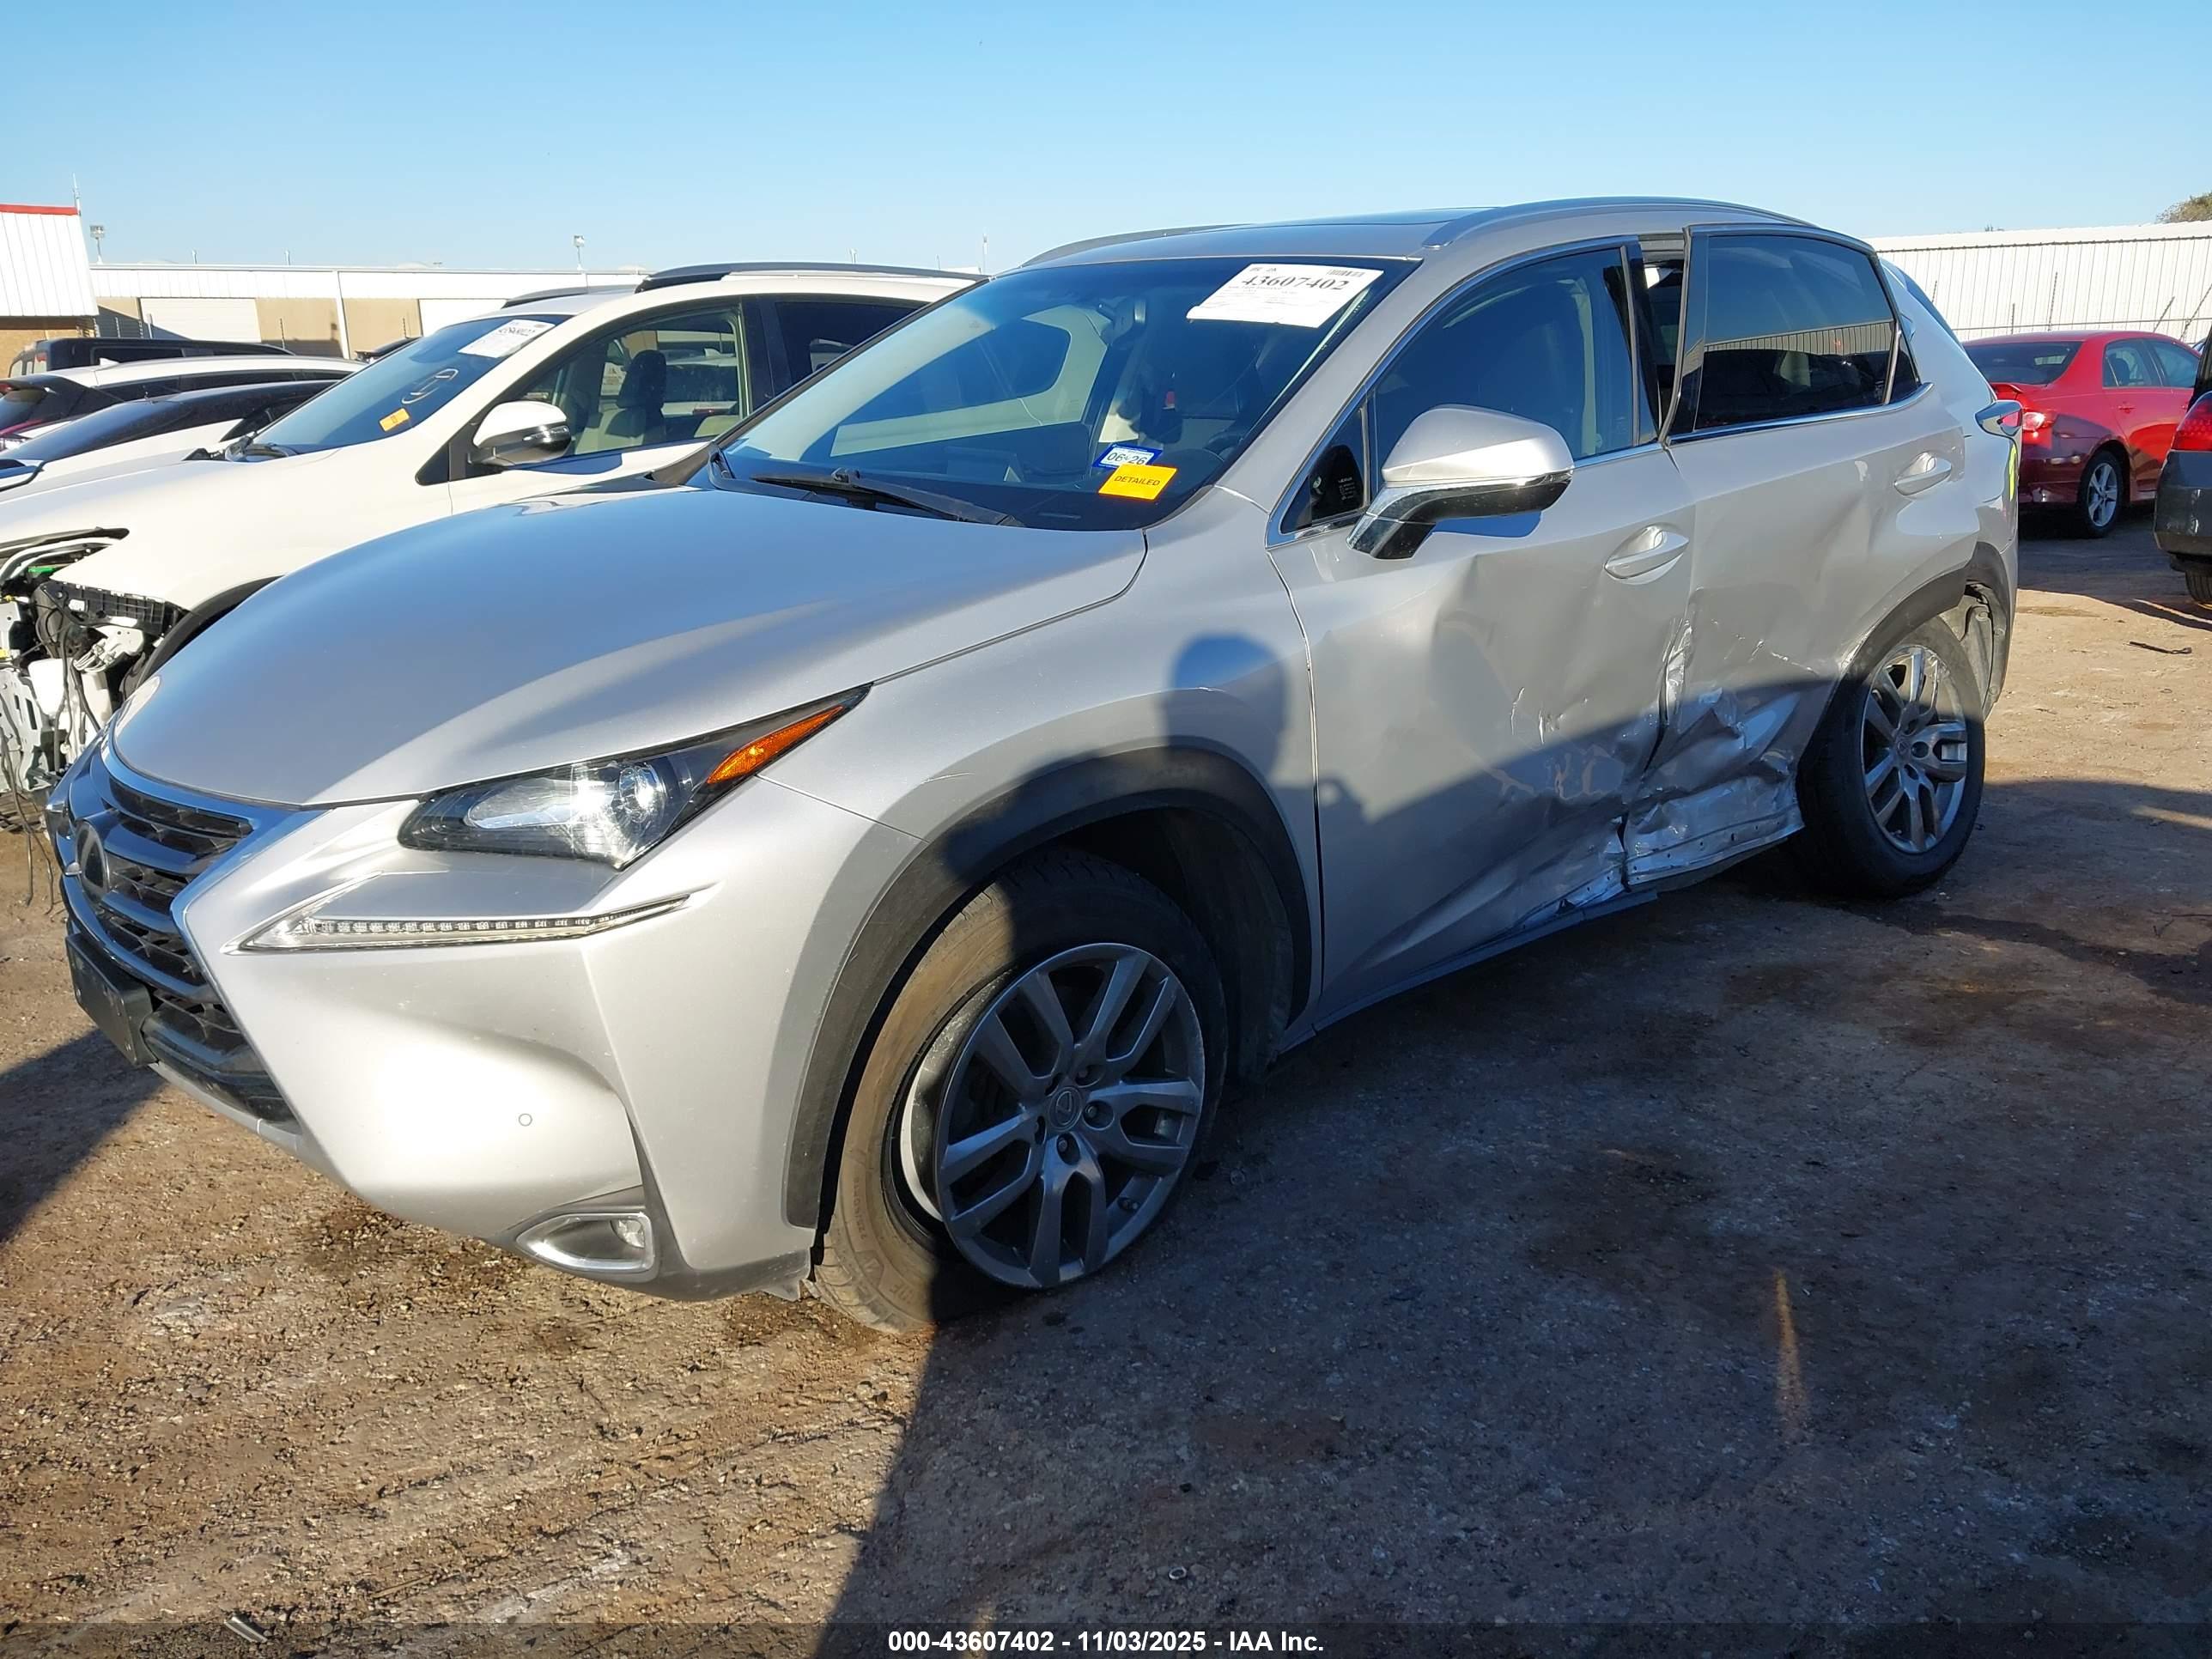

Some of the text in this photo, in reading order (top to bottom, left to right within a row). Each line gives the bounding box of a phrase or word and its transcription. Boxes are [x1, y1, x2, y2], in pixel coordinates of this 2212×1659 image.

[1242, 275, 1351, 290] 43607402
[1106, 452, 1124, 461] 06
[1127, 455, 1148, 465] 26
[1114, 475, 1160, 486] DETAILED
